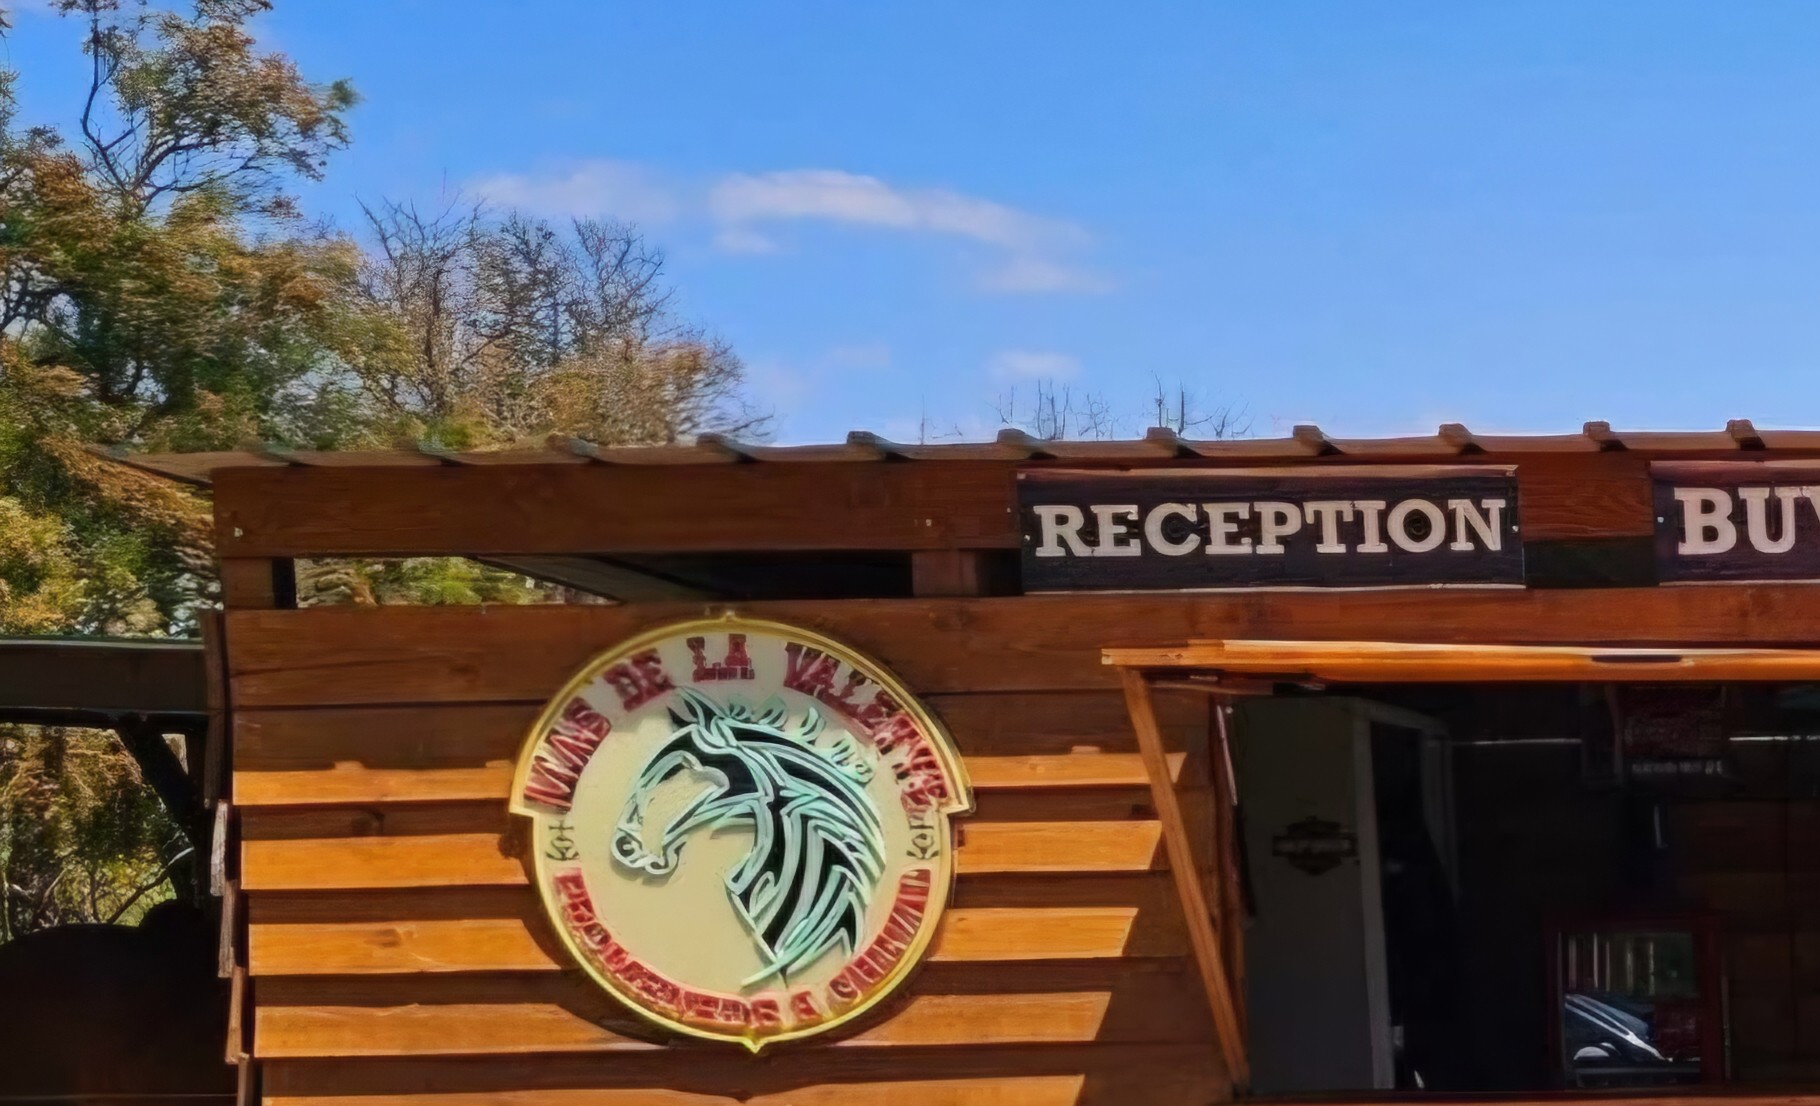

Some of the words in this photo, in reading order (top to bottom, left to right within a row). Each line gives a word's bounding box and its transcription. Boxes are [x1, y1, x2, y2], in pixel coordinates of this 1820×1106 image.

[1031, 498, 1506, 557] RECEPTION
[522, 697, 612, 811] MAS
[602, 648, 676, 711] DE
[686, 633, 755, 682] LA
